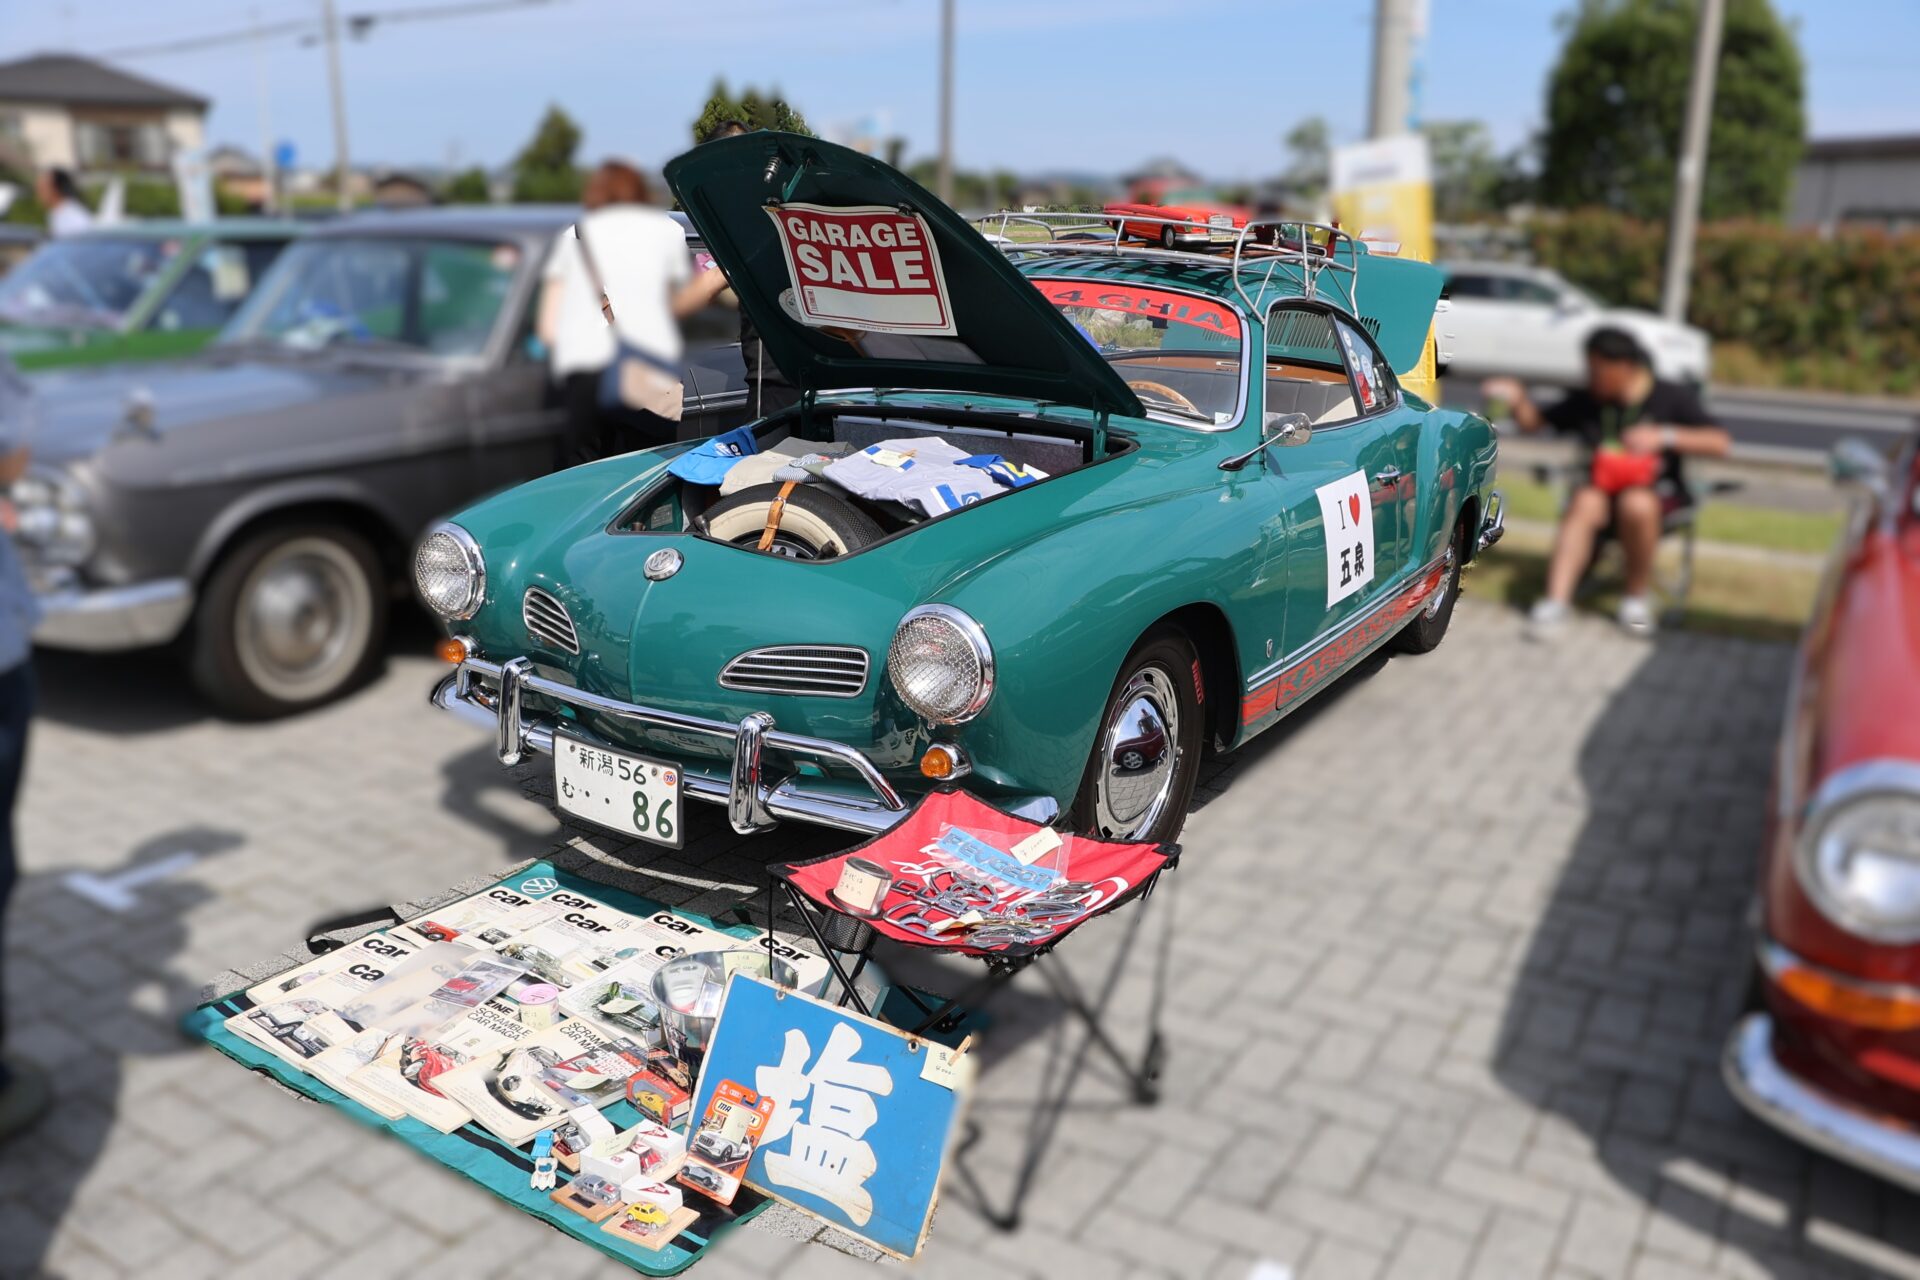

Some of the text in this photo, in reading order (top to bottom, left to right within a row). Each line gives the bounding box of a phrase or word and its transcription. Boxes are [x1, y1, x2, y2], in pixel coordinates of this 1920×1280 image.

[787, 217, 921, 248] GARAGE
[797, 244, 931, 289] SALE
[1098, 294, 1224, 329] GHIA
[1337, 500, 1346, 530] I
[1340, 541, 1365, 588] 五泉
[1282, 606, 1398, 698] KARMANN
[632, 790, 674, 838] 86
[944, 834, 1056, 886] PEUGEOT
[489, 890, 531, 906] car
[551, 894, 597, 910] car
[564, 913, 612, 932] car
[653, 914, 703, 935] car
[363, 939, 410, 957] car
[759, 937, 811, 960] car
[348, 964, 385, 981] ca
[476, 1007, 533, 1037] SCRAMBLE
[484, 999, 514, 1016] ZINE
[467, 1012, 521, 1041] CAR MAGA
[560, 1026, 579, 1041] CAR
[578, 1039, 599, 1053] MA
[569, 1021, 606, 1046] SCRAM
[756, 1022, 893, 1227] 塩
